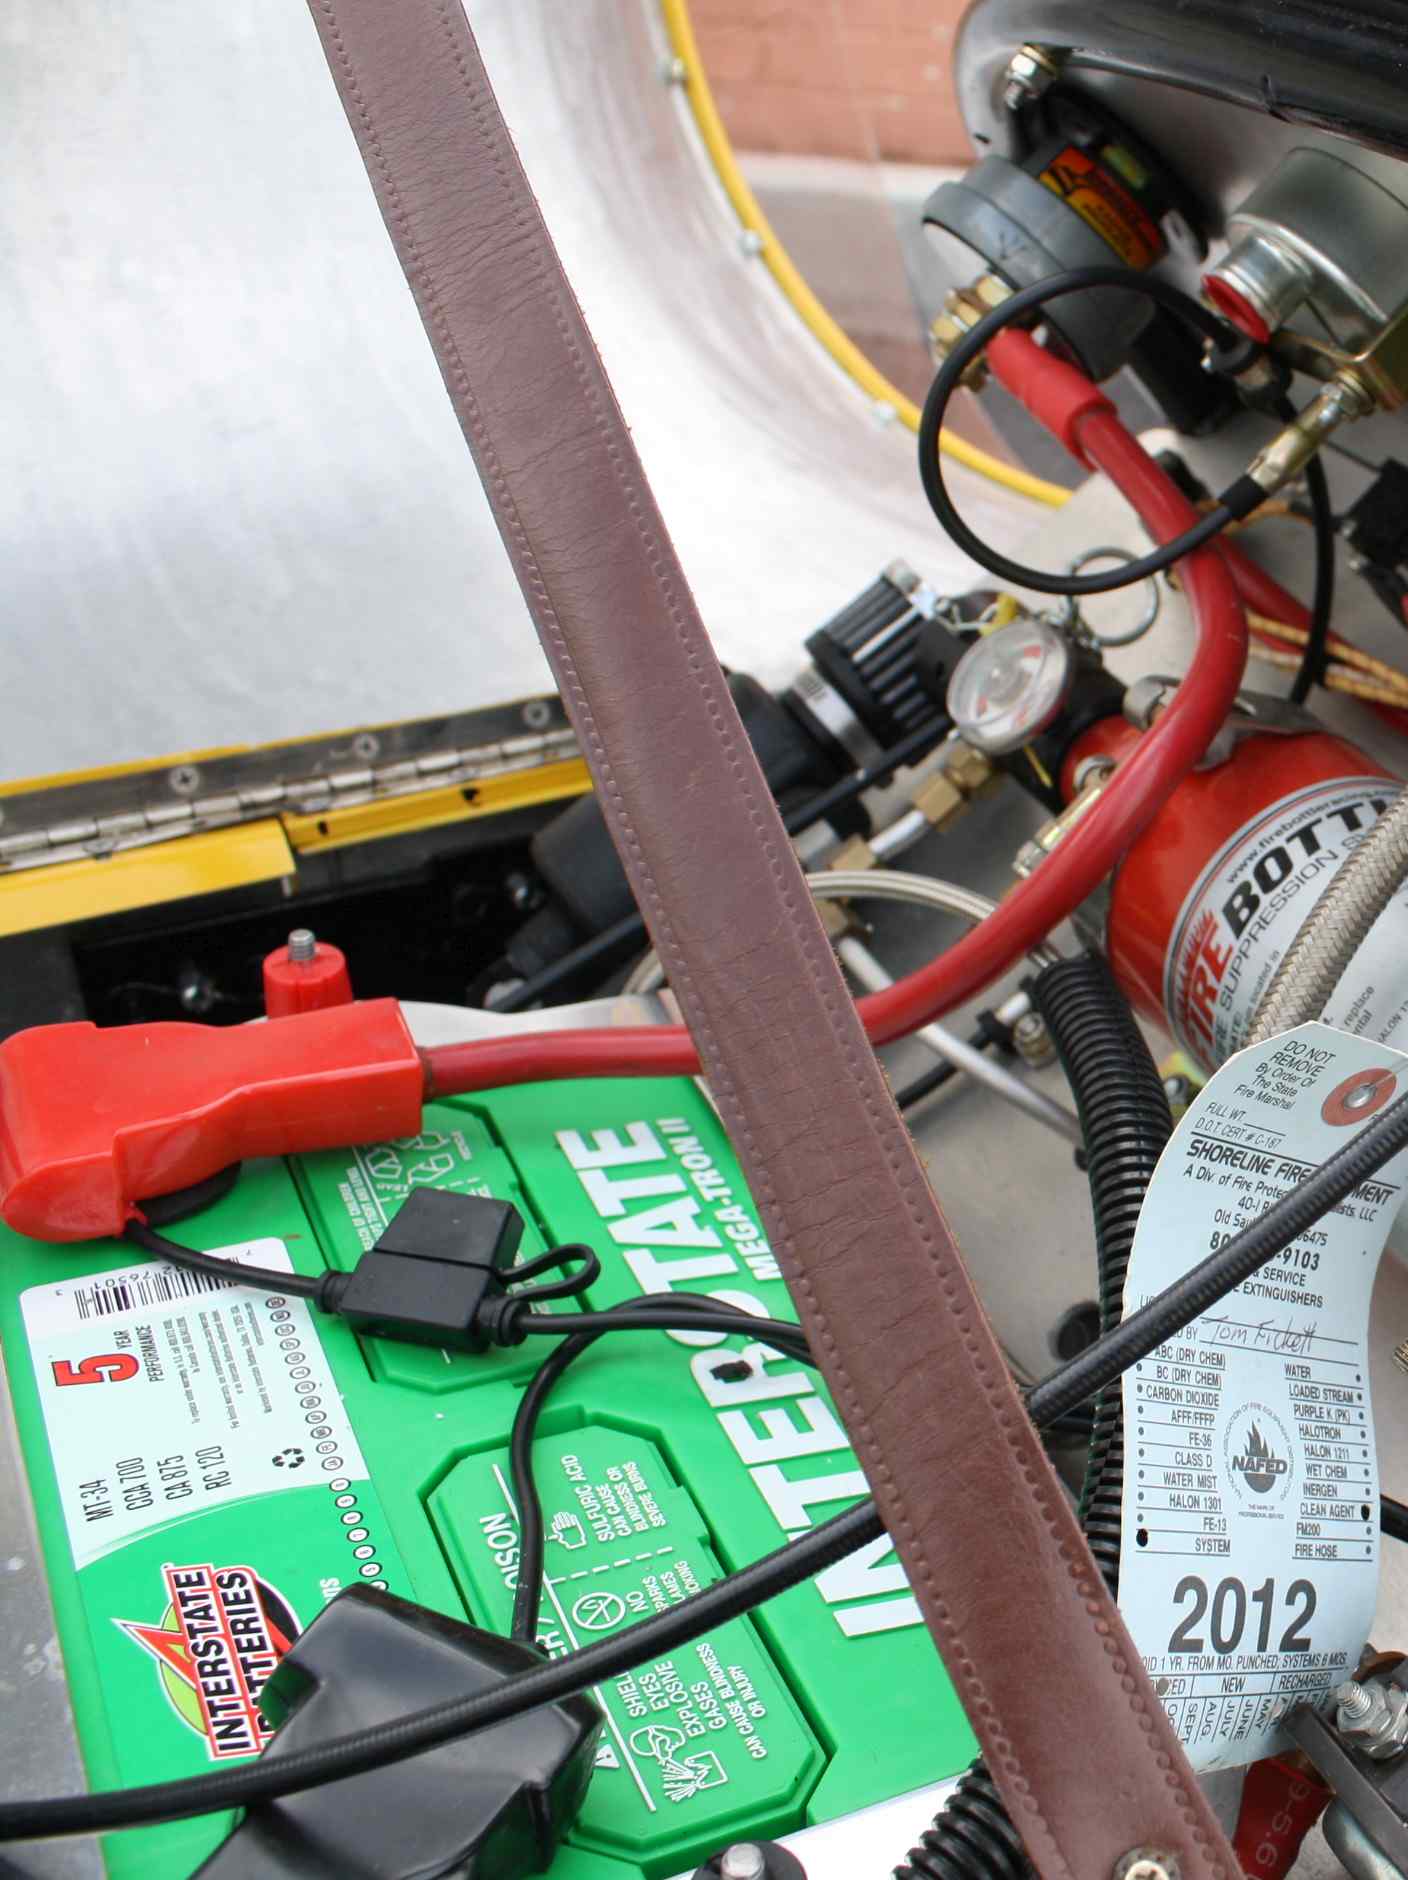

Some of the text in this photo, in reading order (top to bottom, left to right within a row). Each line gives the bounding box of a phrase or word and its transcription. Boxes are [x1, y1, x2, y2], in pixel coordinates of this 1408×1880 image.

[1219, 850, 1339, 1012] SUPPRESSION
[1268, 1049, 1326, 1079] REMOVE
[1283, 1038, 1336, 1066] DO NOT
[1252, 1073, 1298, 1099] The State
[1254, 1061, 1271, 1077] By
[1270, 1065, 1302, 1086] Order
[1205, 1102, 1227, 1118] FULL
[1233, 1083, 1295, 1113] Fire Marshal
[1186, 1139, 1274, 1175] SHORELINE
[1274, 1163, 1312, 1184] FIRE
[1183, 1164, 1193, 1175] A
[1219, 1174, 1231, 1184] of
[1232, 1177, 1253, 1190] Fire
[669, 1130, 781, 1281] MEGA-TRON
[1214, 1211, 1231, 1224] Old
[1263, 1267, 1307, 1287] SERVICE
[1243, 1282, 1324, 1308] EXTINGUISHERS
[52, 1327, 140, 1388] 5 YEAR
[134, 1322, 165, 1384] PERFORMANCE
[1154, 1345, 1227, 1369] ABC (DRY CHEM)
[1156, 1365, 1222, 1388] BC (DRY CHEM)
[1284, 1362, 1312, 1378] WATER
[1144, 1384, 1220, 1407] CARBON DIOXIDE
[1287, 1383, 1354, 1403] LOADED STREAM
[1292, 1403, 1323, 1418] PURPLE
[1297, 1423, 1342, 1440] HALOTRON
[193, 1444, 226, 1470] 120
[1174, 1451, 1203, 1467] CLASS
[1303, 1443, 1332, 1458] HALON
[155, 1453, 188, 1482] 875
[1232, 1455, 1287, 1474] NAFED
[1304, 1463, 1347, 1480] WET CHEM
[114, 1456, 154, 1512] CCA 700
[162, 1479, 193, 1500] CA
[201, 1469, 232, 1491] RC
[1162, 1471, 1217, 1489] WATER MIST
[1302, 1482, 1338, 1498] INERGEN
[77, 1477, 113, 1522] MT-34
[561, 1453, 614, 1543] SULFURIC ACID
[615, 1480, 647, 1532] BLINDNESS
[623, 1460, 665, 1528] SEVERE BURNS
[1168, 1492, 1222, 1510] HALON 1301
[597, 1483, 630, 1536] CAN CAUSE
[1299, 1501, 1326, 1517] CLEAN
[1328, 1504, 1355, 1519] AGENT
[1202, 1516, 1227, 1532] FE-13
[1295, 1521, 1321, 1536] FM200
[479, 1510, 521, 1590] OISON
[1194, 1536, 1231, 1554] SYSTEM
[1294, 1541, 1338, 1558] FIRE HOSE
[626, 1589, 647, 1613] NO
[1168, 1575, 1317, 1654] 2012
[172, 1565, 251, 1755] INTERSTATE
[1187, 1654, 1215, 1671] FROM
[1281, 1652, 1321, 1669] SYSTEMS
[639, 1672, 668, 1711] EYES
[728, 1662, 765, 1717] OR INJURY
[1220, 1670, 1332, 1693] NEW RECHARGED
[655, 1658, 704, 1738] EXPLOSIVE
[690, 1679, 726, 1730] GASES
[697, 1641, 768, 1759] CAN CAUSE BLINDNESS
[1200, 1702, 1217, 1737] AUG
[1218, 1701, 1236, 1737] JULY
[1235, 1699, 1254, 1740] JUNE
[1255, 1698, 1272, 1730] MAY
